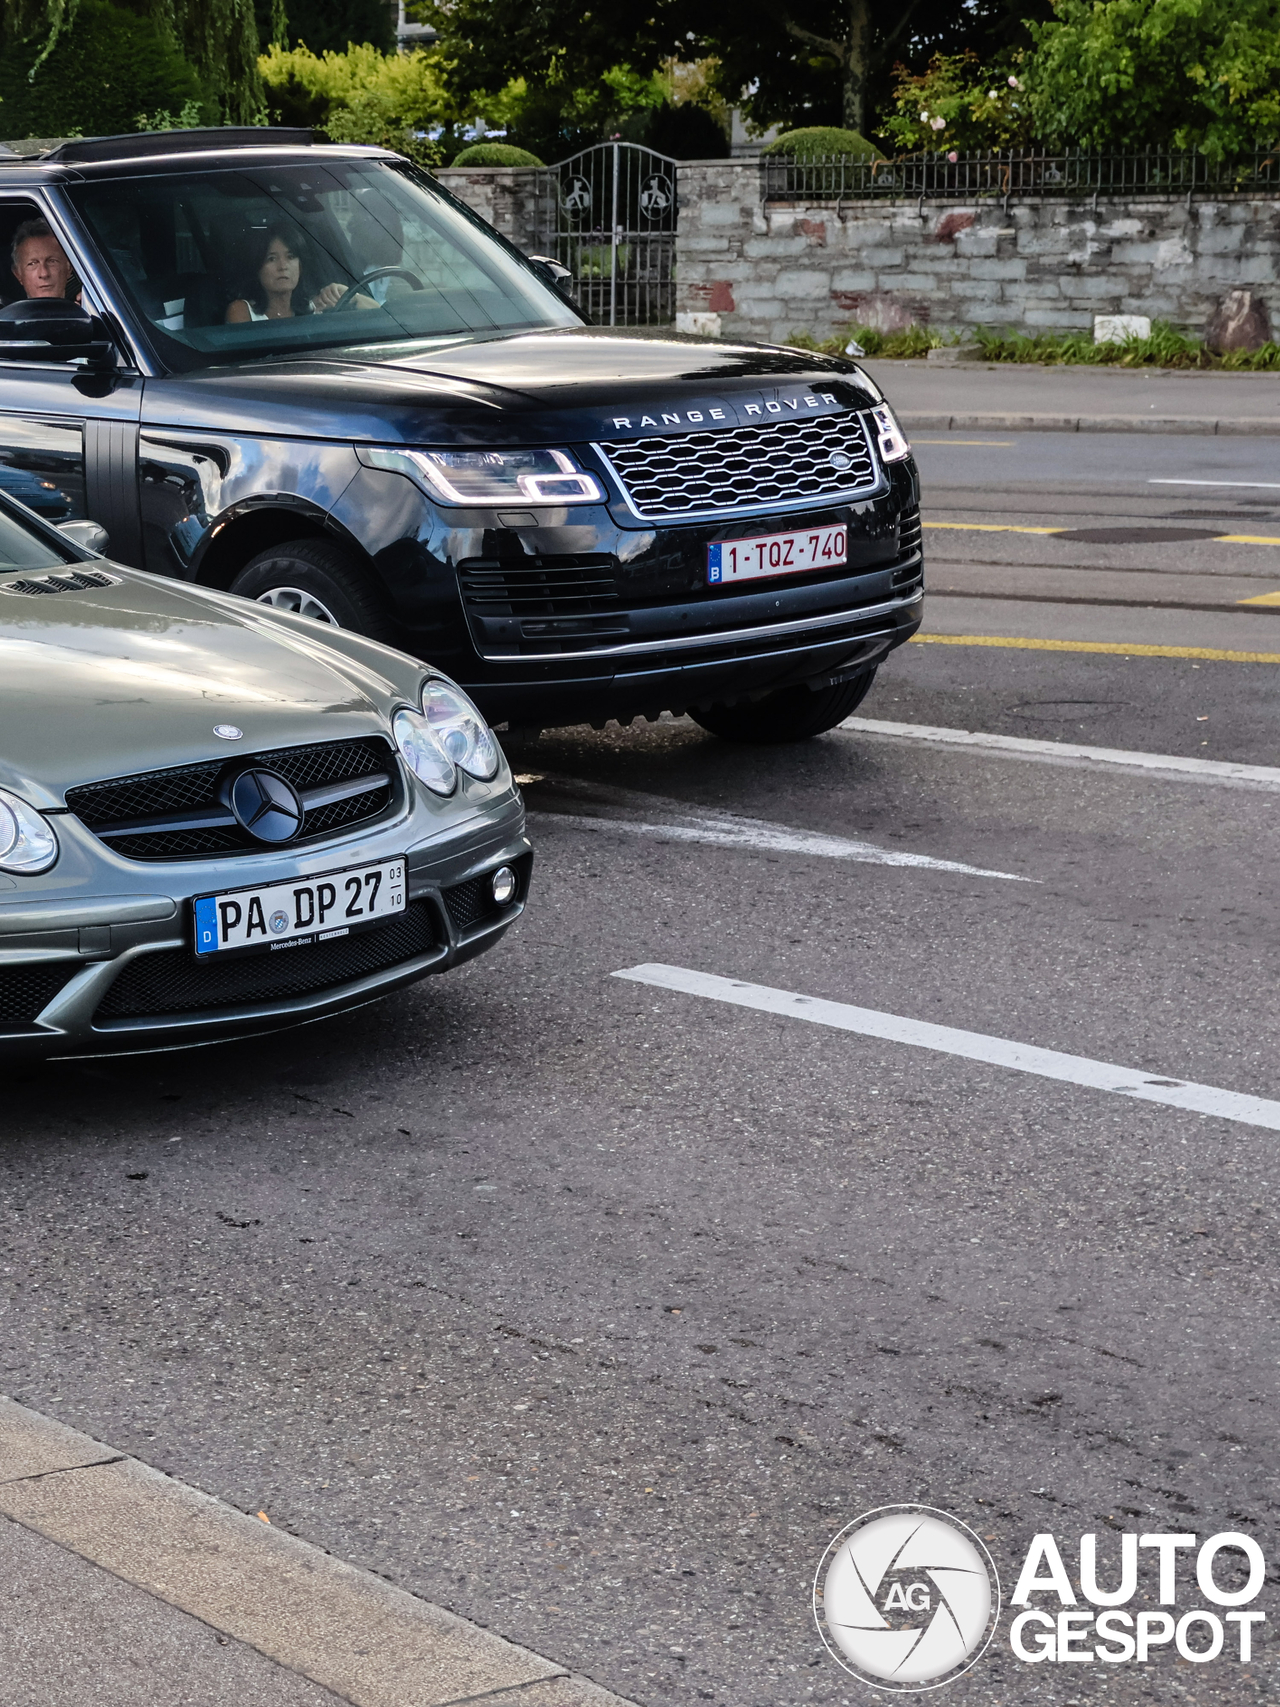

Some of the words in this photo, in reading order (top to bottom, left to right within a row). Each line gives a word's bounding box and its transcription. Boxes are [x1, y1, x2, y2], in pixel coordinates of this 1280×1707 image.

[612, 407, 726, 430] RANGE
[744, 393, 839, 416] ROVER
[728, 531, 846, 574] 1-TQZ-740
[710, 566, 720, 580] B
[389, 866, 402, 880] 03
[218, 896, 268, 943] PA
[293, 882, 337, 929] DP
[345, 871, 382, 918] 27
[390, 893, 402, 907] 10
[203, 930, 212, 943] D
[270, 937, 312, 951] Mercedes-Benz
